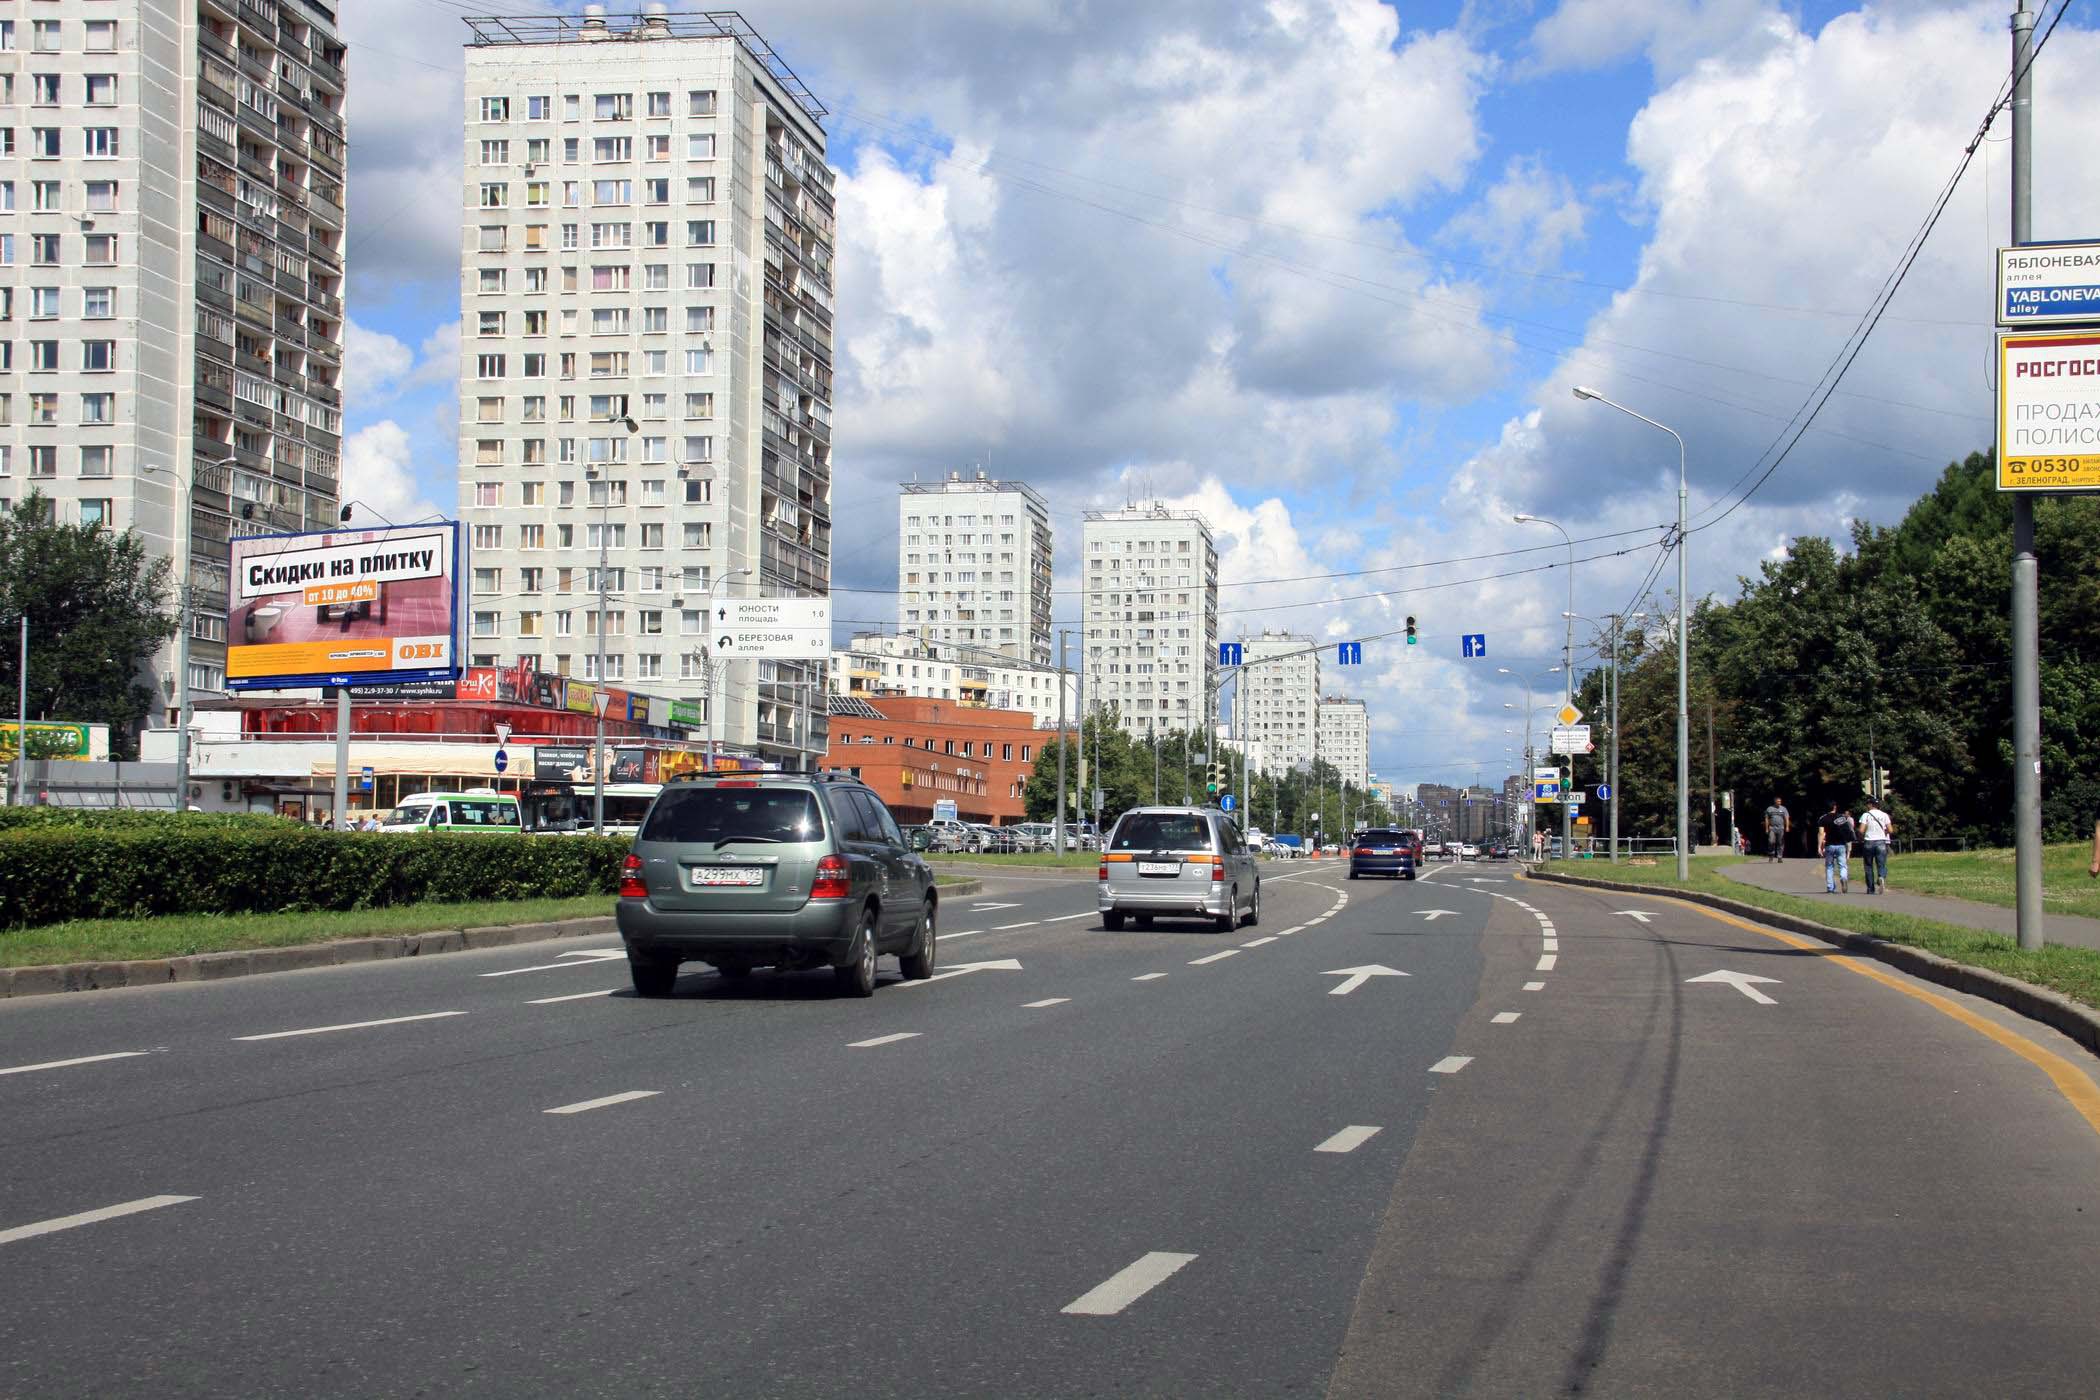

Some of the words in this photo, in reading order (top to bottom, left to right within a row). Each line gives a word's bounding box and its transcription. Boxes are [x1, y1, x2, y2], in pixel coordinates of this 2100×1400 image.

[2009, 305, 2039, 314] alley
[2016, 427, 2100, 445] ПОЛИС
[2031, 458, 2080, 473] 0530
[249, 561, 325, 587] Скидки
[330, 558, 354, 577] на
[360, 549, 434, 574] плитку
[308, 591, 319, 602] от
[321, 589, 334, 601] 10
[335, 589, 348, 601] до
[351, 584, 373, 597] 40%
[738, 605, 779, 613] ЮНОСТИ
[738, 615, 778, 623] площадь
[738, 633, 794, 642] БЕРЕЗОВАЯ
[811, 639, 824, 647] 0.3
[399, 643, 444, 659] OBI
